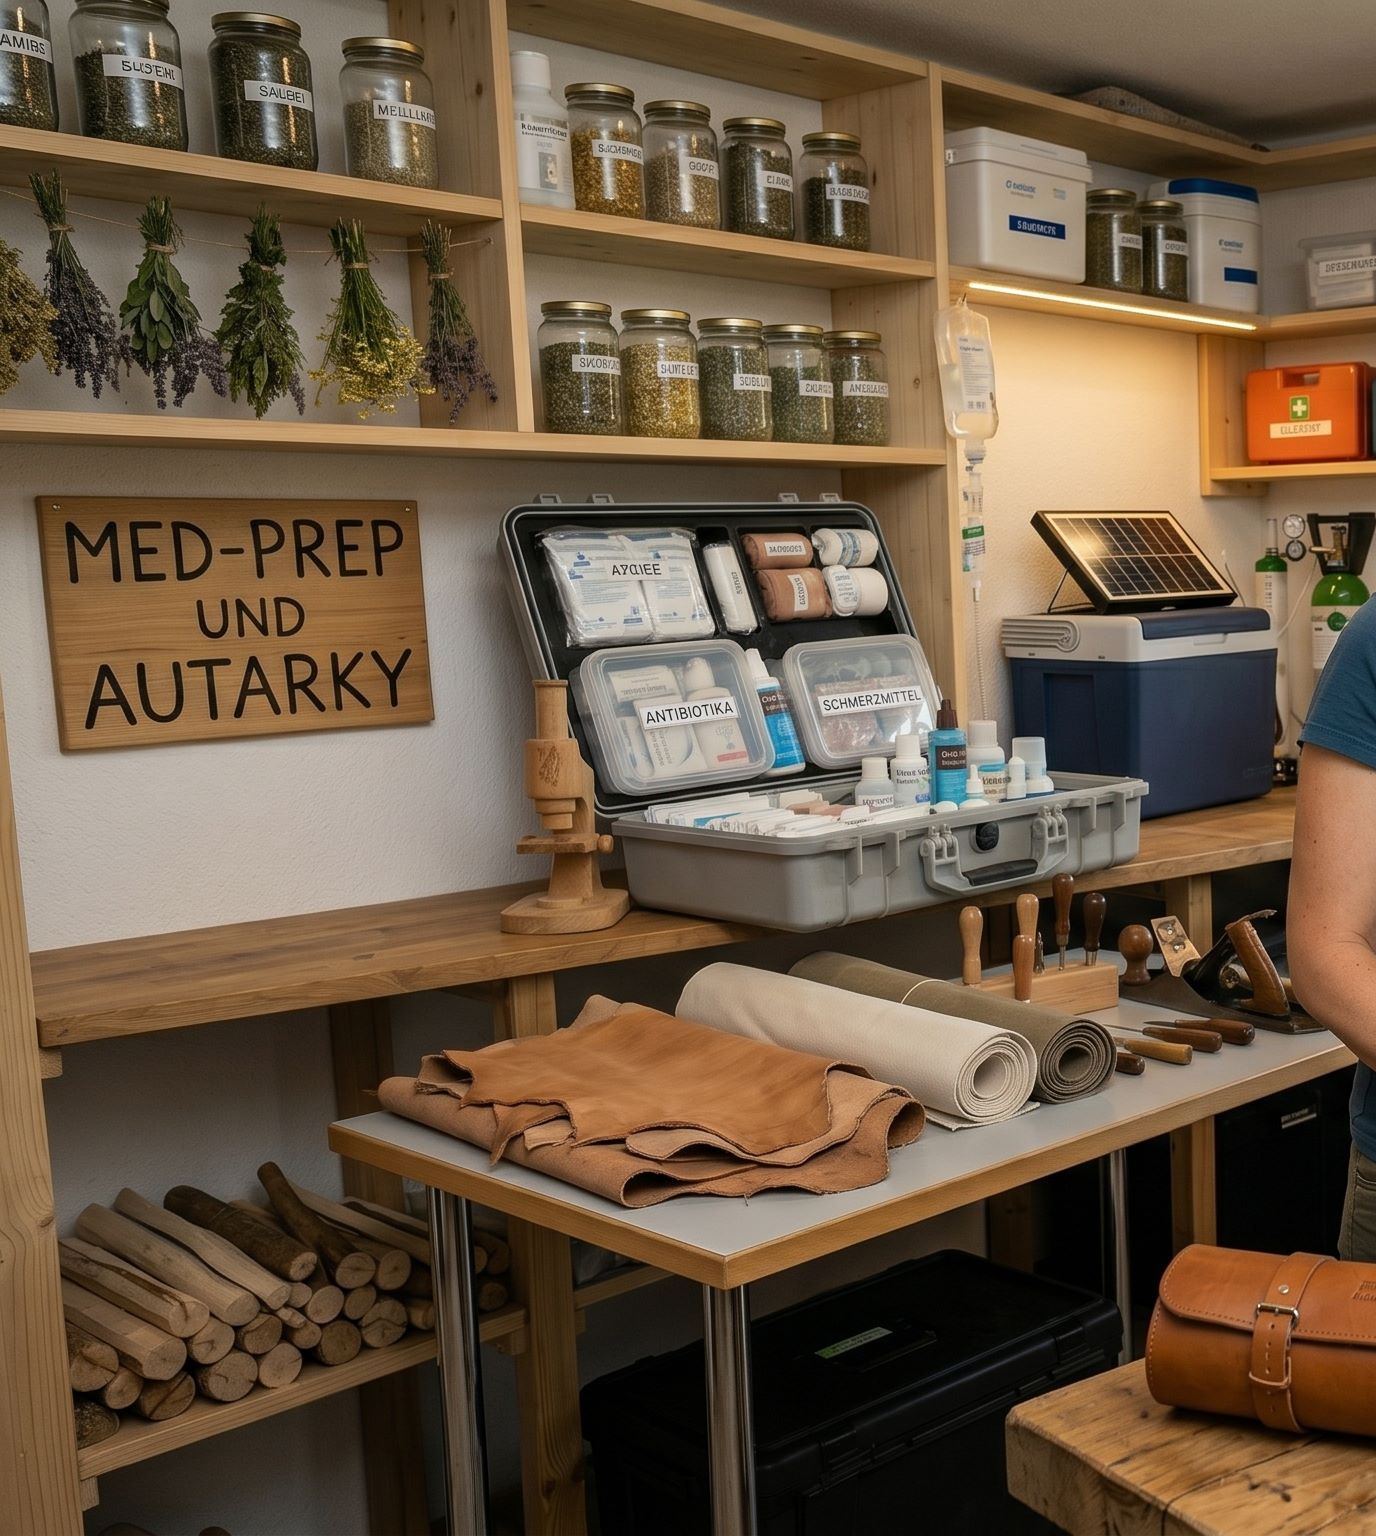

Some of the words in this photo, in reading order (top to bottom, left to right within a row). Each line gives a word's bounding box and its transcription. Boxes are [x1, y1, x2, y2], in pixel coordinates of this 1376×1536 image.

[65, 518, 404, 583] MED-PREP
[196, 597, 305, 639] UND
[84, 648, 412, 729] AUTARKY
[646, 701, 734, 724] ANTIBIOTIKA
